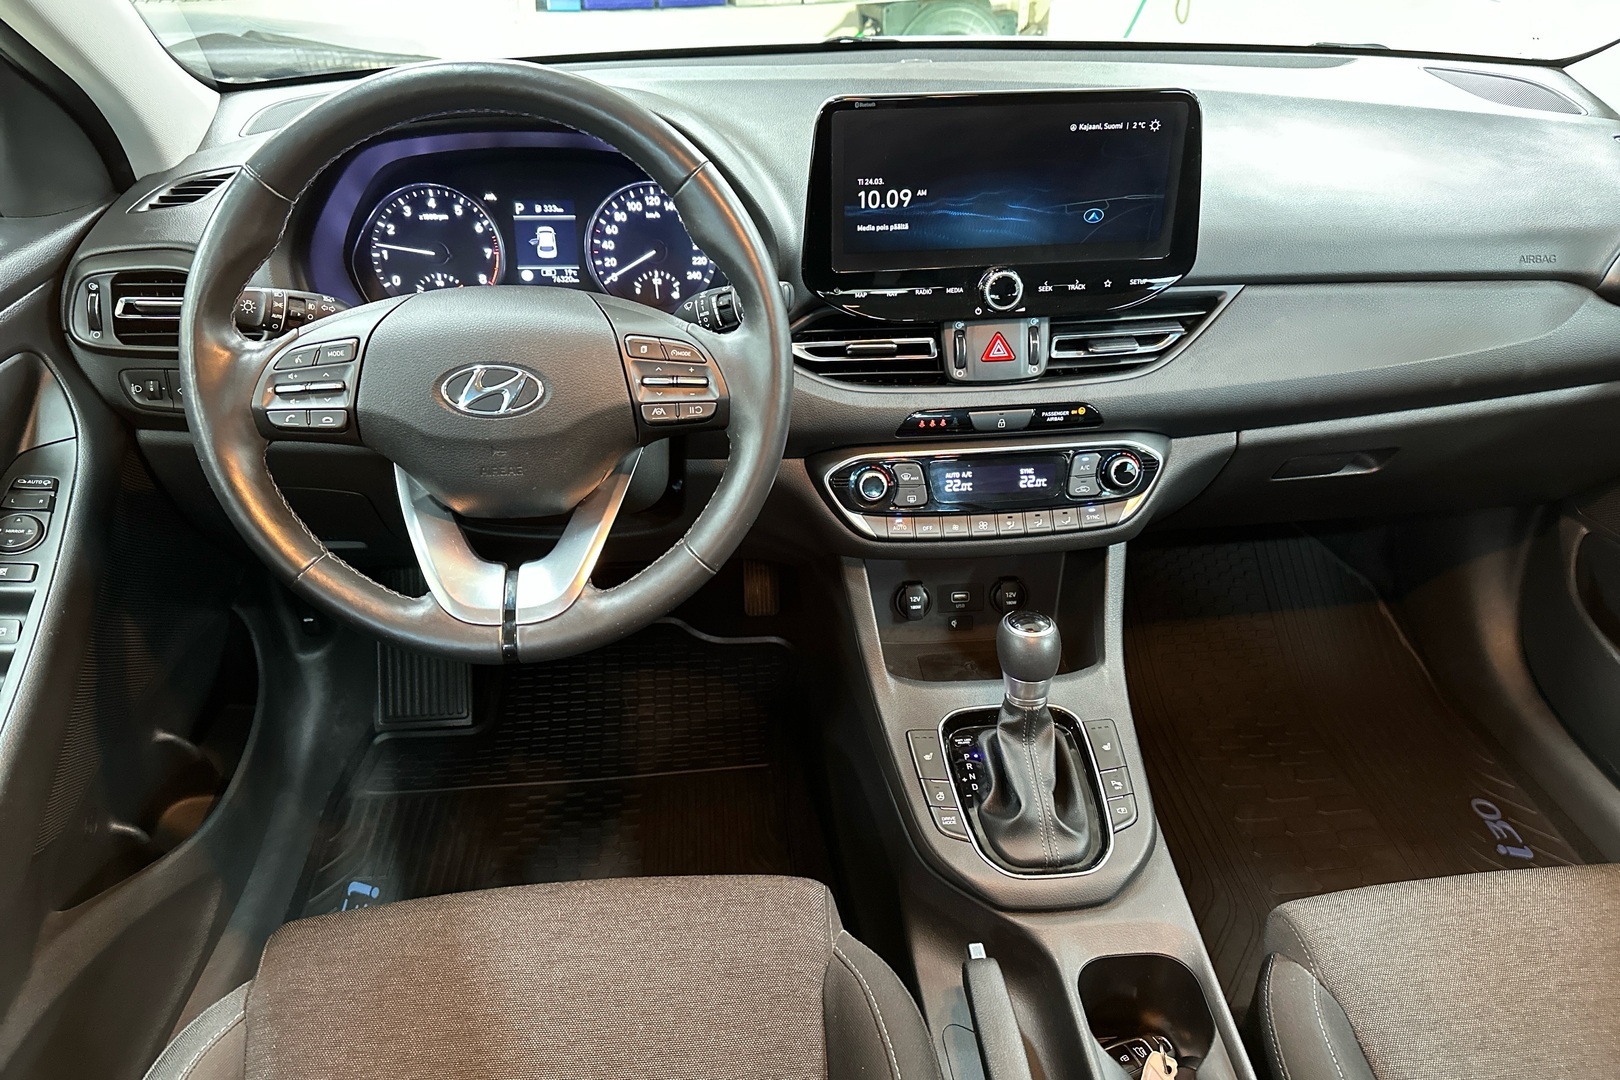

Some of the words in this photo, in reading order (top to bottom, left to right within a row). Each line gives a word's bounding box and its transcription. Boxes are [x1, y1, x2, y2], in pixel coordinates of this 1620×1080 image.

[864, 177, 885, 186] 24.03.
[427, 197, 437, 209] 4
[645, 196, 661, 206] 120
[857, 188, 913, 209] 10.09
[402, 205, 412, 218] 3
[454, 204, 463, 216] 5
[514, 202, 525, 215] P
[626, 201, 643, 212] 100
[613, 211, 628, 222] 80
[386, 223, 396, 235] 2
[474, 221, 484, 234] 6
[605, 224, 619, 235] 60
[857, 224, 875, 232] Media
[601, 240, 615, 250] 40
[381, 249, 389, 261] 1
[482, 247, 493, 260] 7
[604, 257, 618, 267] 20
[691, 256, 708, 266] 220
[1519, 254, 1557, 264] AIRBAG
[391, 274, 402, 287] 0
[478, 273, 488, 285] 8
[686, 271, 703, 281] 240
[915, 288, 933, 296] RADIO
[1038, 285, 1053, 293] SEEK
[1067, 283, 1086, 291] TRACK
[327, 349, 345, 357] MODE
[961, 470, 973, 479] A/C
[1019, 467, 1035, 475] SYNC
[966, 762, 974, 770] R
[968, 772, 977, 780] N
[971, 783, 979, 791] D
